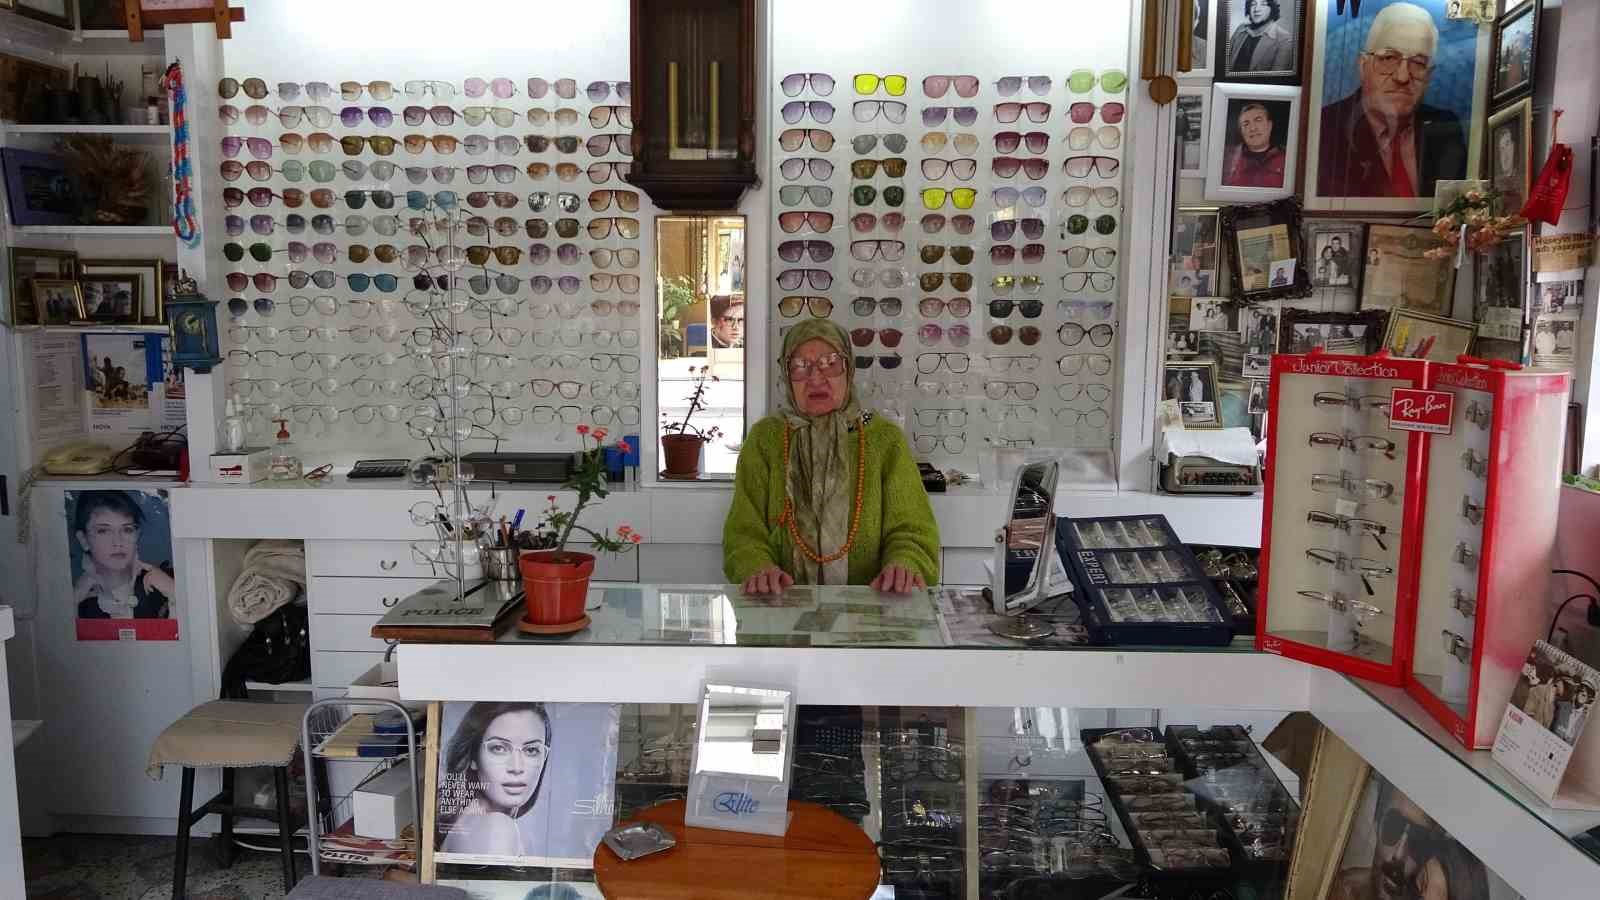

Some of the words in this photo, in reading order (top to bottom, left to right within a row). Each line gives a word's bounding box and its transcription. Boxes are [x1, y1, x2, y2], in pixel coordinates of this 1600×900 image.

[1293, 358, 1332, 373] Junior
[1333, 360, 1398, 378] Collection
[1395, 394, 1447, 420] Ray-Ban
[1080, 551, 1109, 585] EXPERT
[400, 607, 485, 617] POLICE
[452, 790, 475, 799] WEAR
